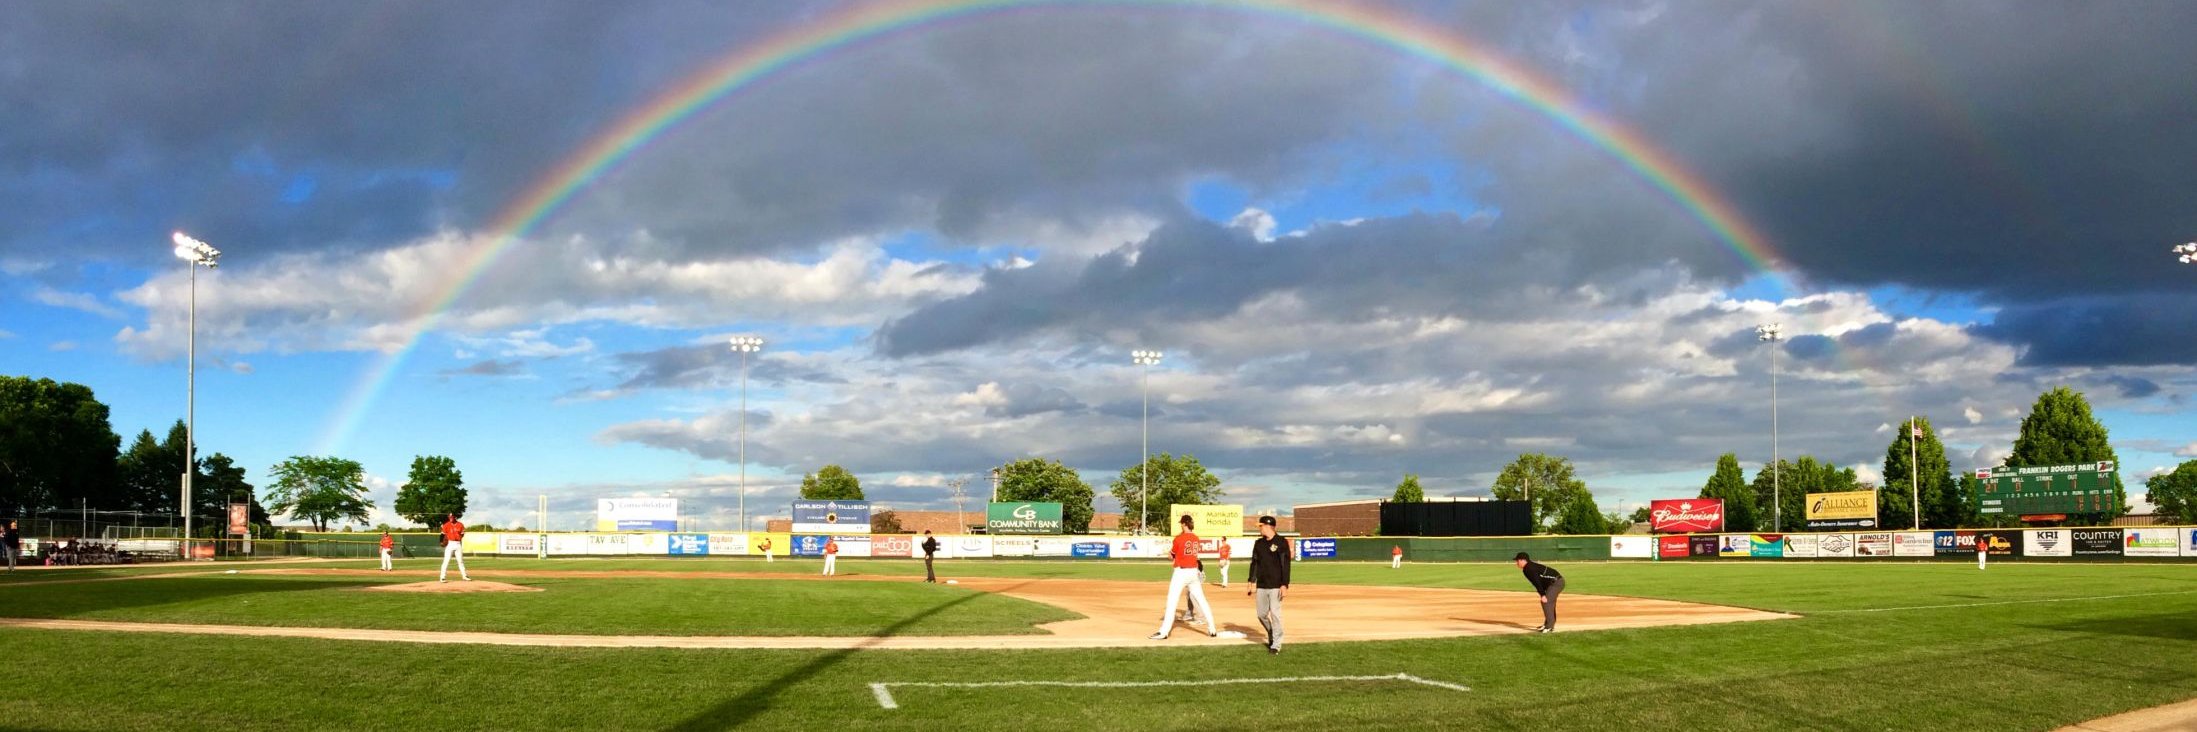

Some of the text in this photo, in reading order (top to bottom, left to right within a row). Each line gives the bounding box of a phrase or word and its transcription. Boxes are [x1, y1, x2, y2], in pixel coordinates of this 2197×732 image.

[2018, 467, 2048, 475] FRANKLIN
[2050, 465, 2076, 473] ROGERS
[1825, 498, 1868, 508] ALLIANCE
[1653, 510, 1719, 523] Budweiser
[989, 520, 1059, 528] COMMUNITY BANK
[590, 536, 626, 544] TAV AVE
[1942, 536, 1953, 546] 12
[1956, 535, 1976, 545] FOX
